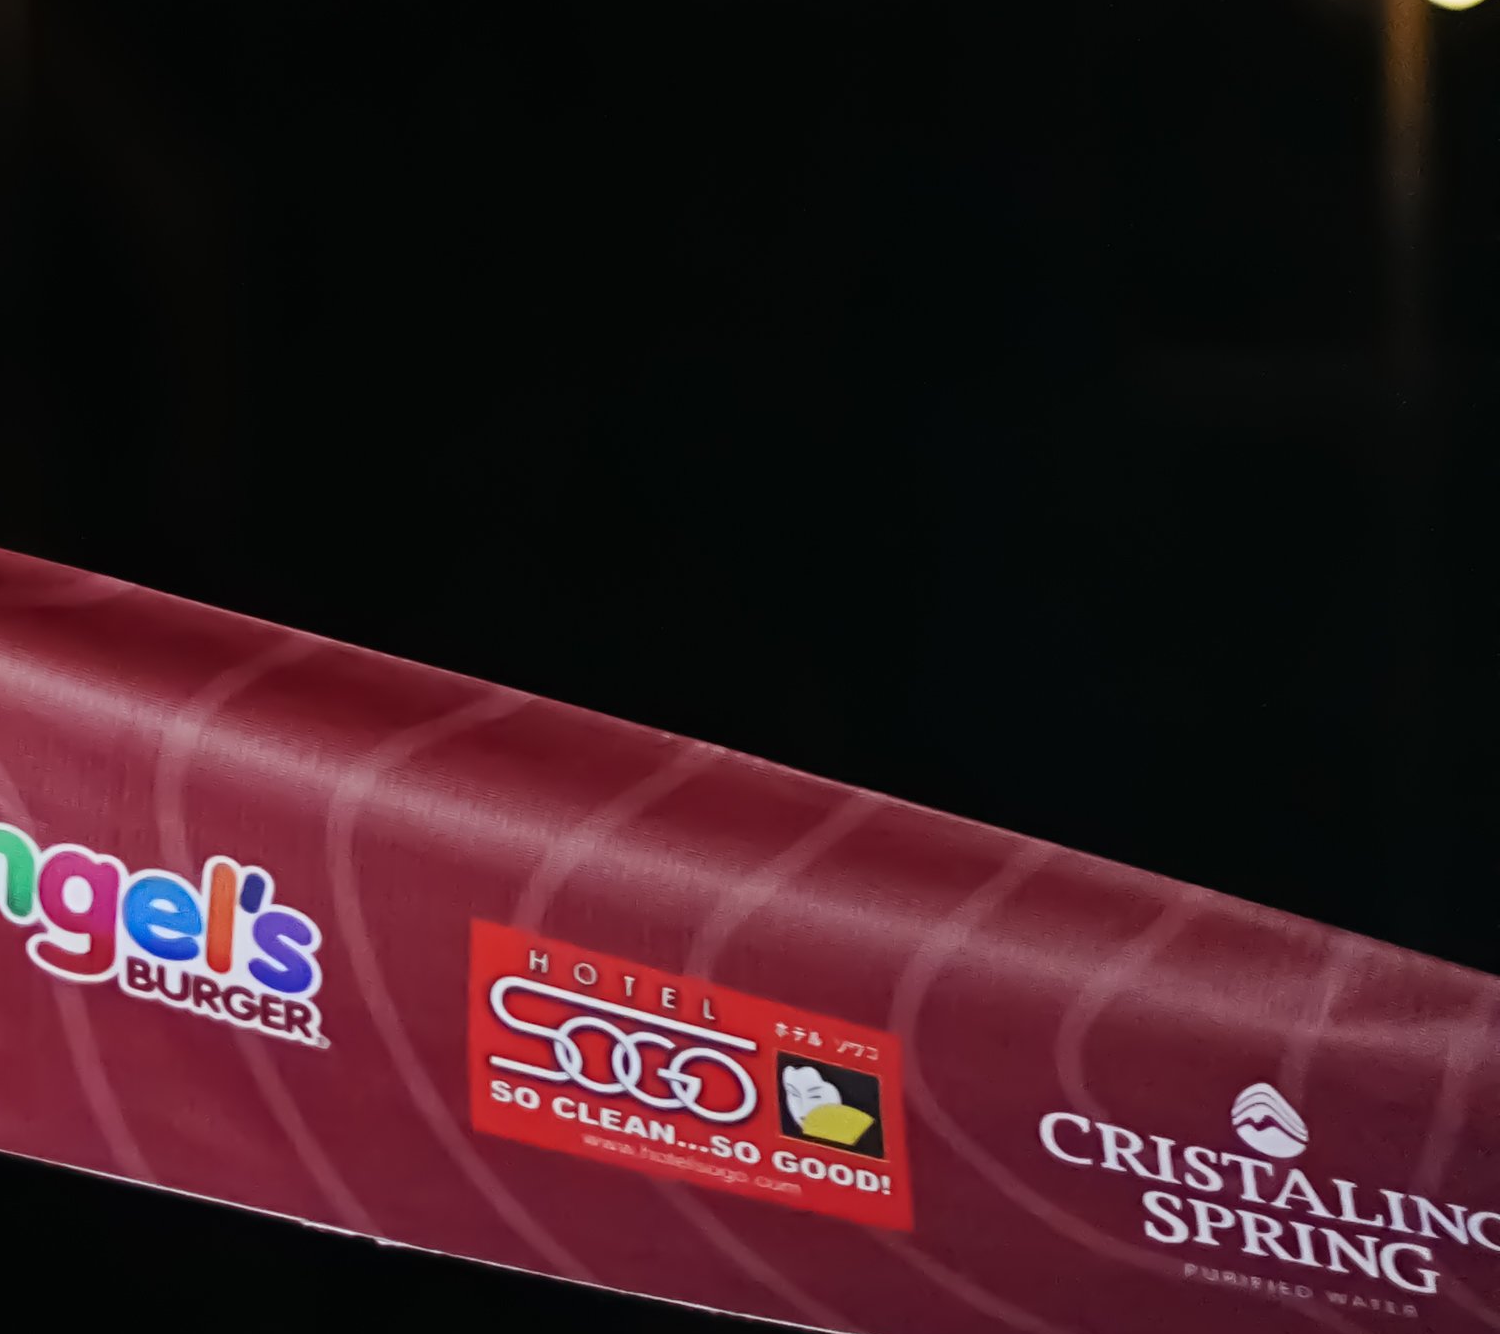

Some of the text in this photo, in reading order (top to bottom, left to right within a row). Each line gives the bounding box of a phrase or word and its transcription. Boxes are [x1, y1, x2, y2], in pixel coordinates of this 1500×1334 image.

[126, 956, 313, 1038] BURGER
[529, 949, 717, 1021] HOTEL
[490, 1080, 540, 1111] SO
[771, 1150, 893, 1196] GOOD!
[1141, 1189, 1441, 1294] SPRING
